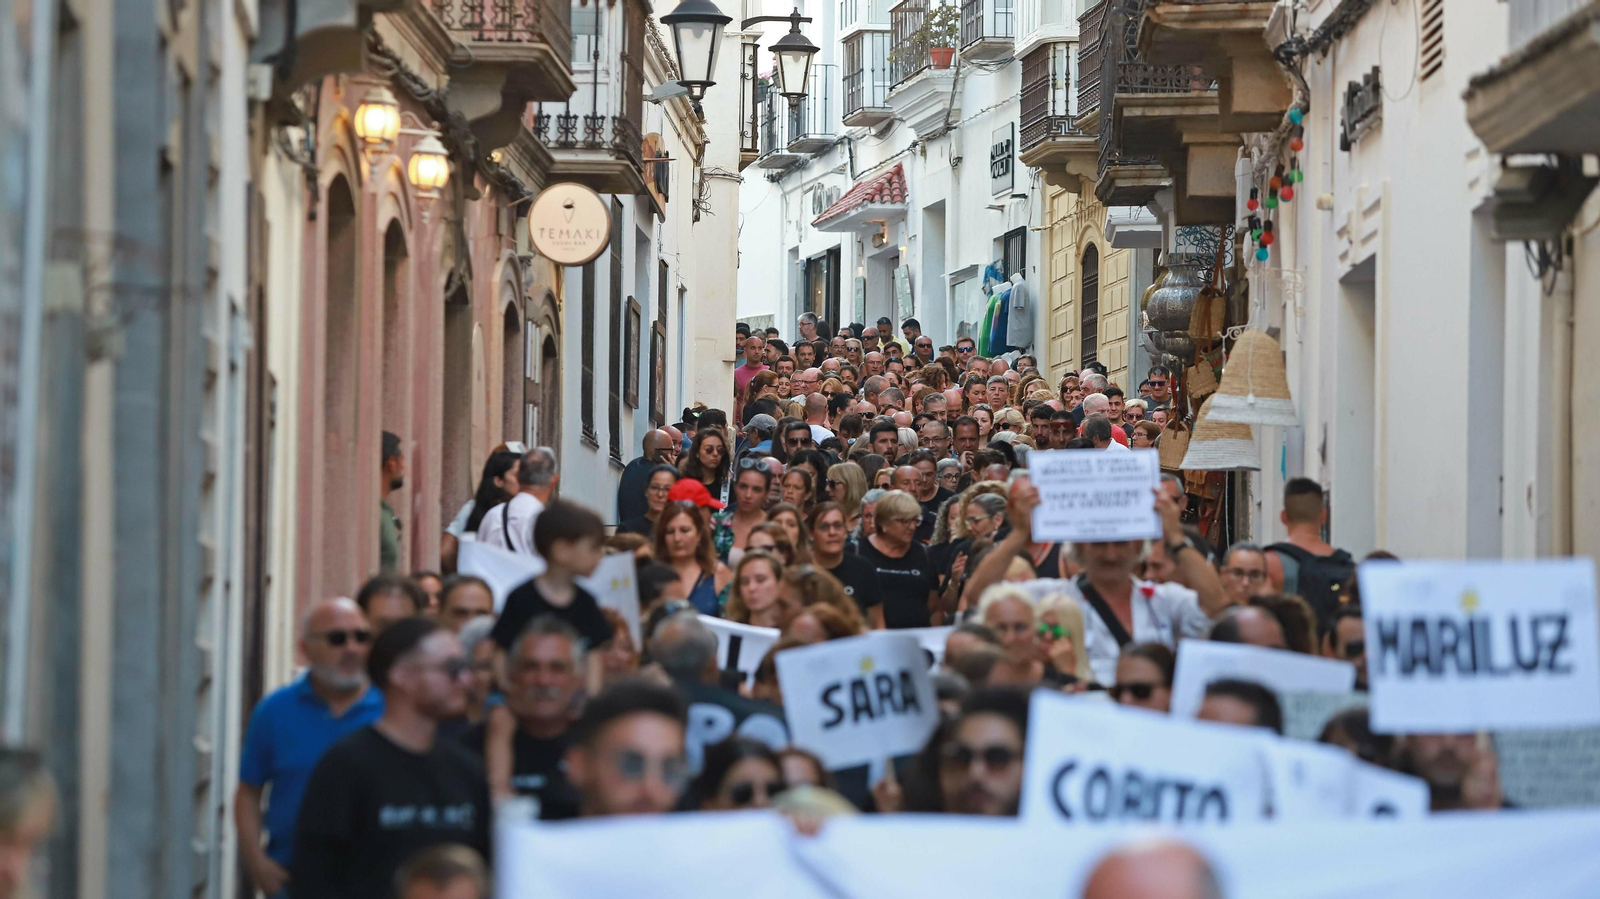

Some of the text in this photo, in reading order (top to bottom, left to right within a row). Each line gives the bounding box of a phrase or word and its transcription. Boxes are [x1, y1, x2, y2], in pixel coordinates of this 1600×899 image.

[538, 227, 600, 239] TEMAKI
[1376, 614, 1573, 676] MARILUZ
[820, 671, 922, 730] SARA
